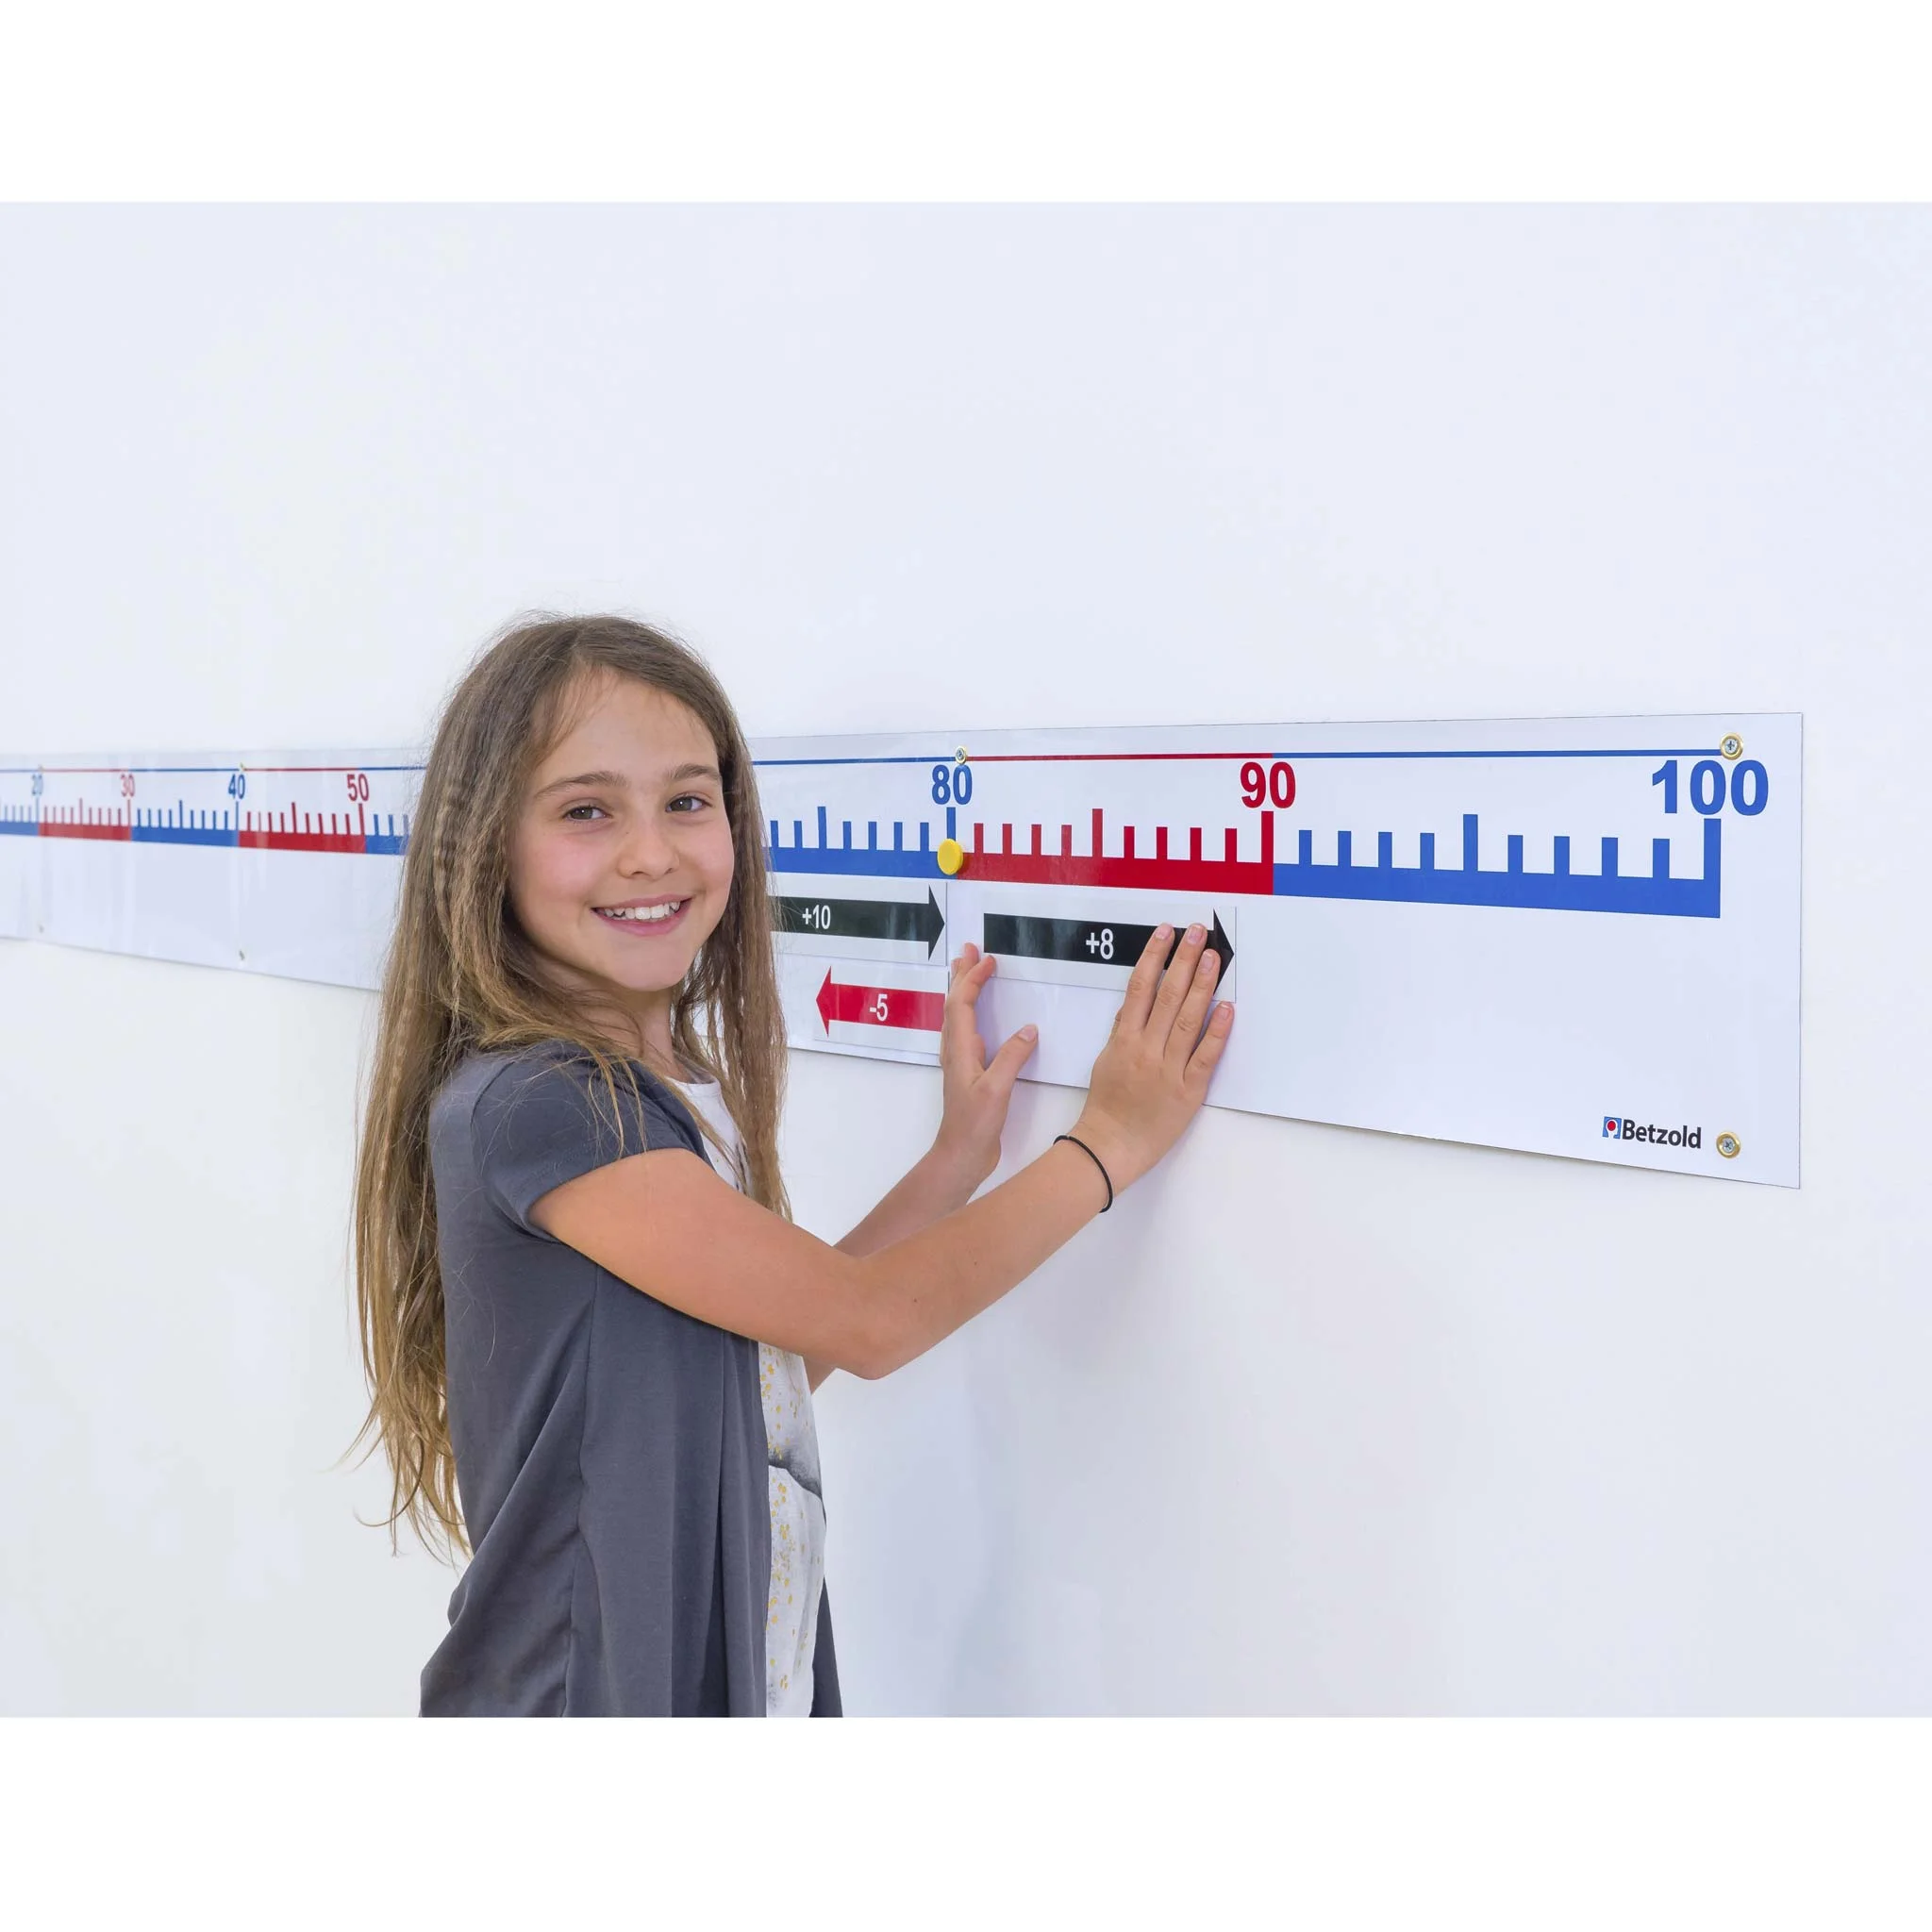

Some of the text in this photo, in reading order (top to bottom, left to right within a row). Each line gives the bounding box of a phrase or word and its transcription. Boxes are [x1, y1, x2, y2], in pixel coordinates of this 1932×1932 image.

[31, 774, 44, 796] 20
[121, 773, 136, 797] 30
[228, 774, 245, 800] 40
[347, 774, 369, 802] 50
[931, 764, 973, 805] 80
[1240, 761, 1296, 808] 90
[1652, 759, 1769, 817] 100
[801, 905, 831, 929] +10
[1085, 928, 1114, 959] +8
[869, 994, 889, 1022] -5
[1623, 1119, 1702, 1149] Betzold
